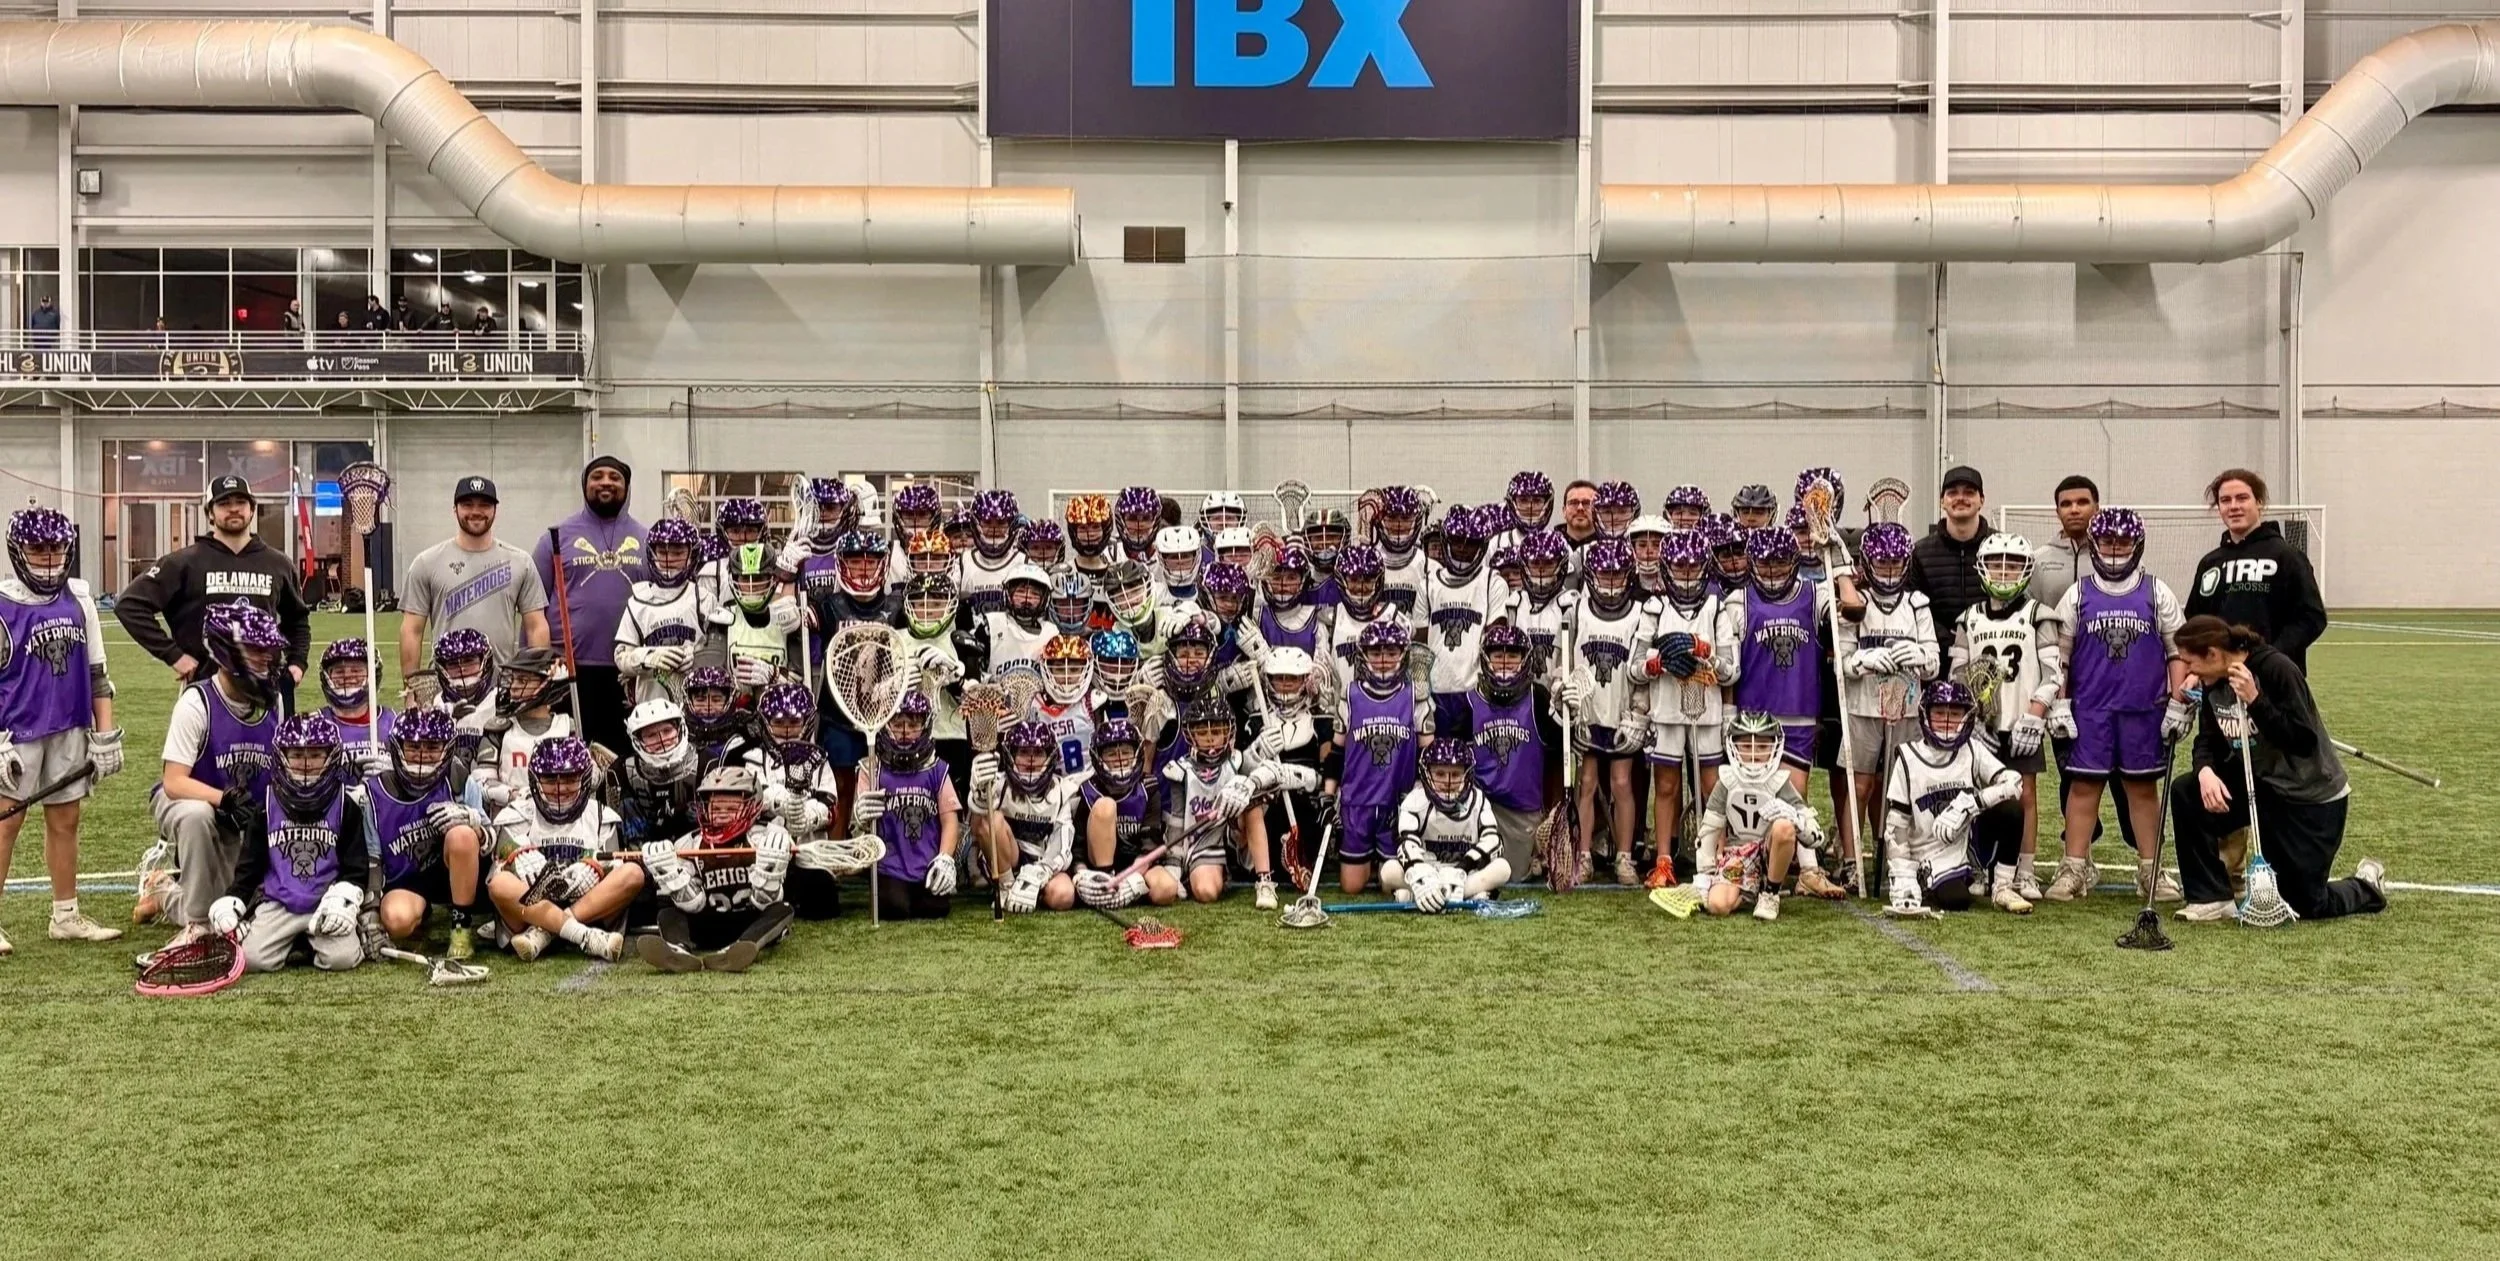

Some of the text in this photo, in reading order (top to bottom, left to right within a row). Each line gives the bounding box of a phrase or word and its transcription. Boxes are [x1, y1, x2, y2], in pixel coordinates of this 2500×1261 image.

[1132, 0, 1434, 88] IBX
[0, 353, 92, 373] HL UNION
[186, 352, 217, 363] UNION
[319, 356, 335, 371] tv
[428, 353, 533, 373] PHL UNION
[573, 556, 597, 567] STICK
[622, 557, 643, 567] WORK
[206, 571, 273, 588] DELAWARE
[2096, 609, 2138, 619] PHILADELPHIA
[1754, 625, 1810, 644] WATERDOGS
[2086, 617, 2151, 634] WATERDOGS
[24, 626, 87, 656] WATERDOGS
[1352, 724, 1410, 742] WATERDOGS
[1474, 727, 1530, 747] WATERDOGS
[215, 750, 273, 770] WATERDOGS
[886, 794, 938, 816] WATERDOGS
[267, 827, 339, 848] WATERDOGS
